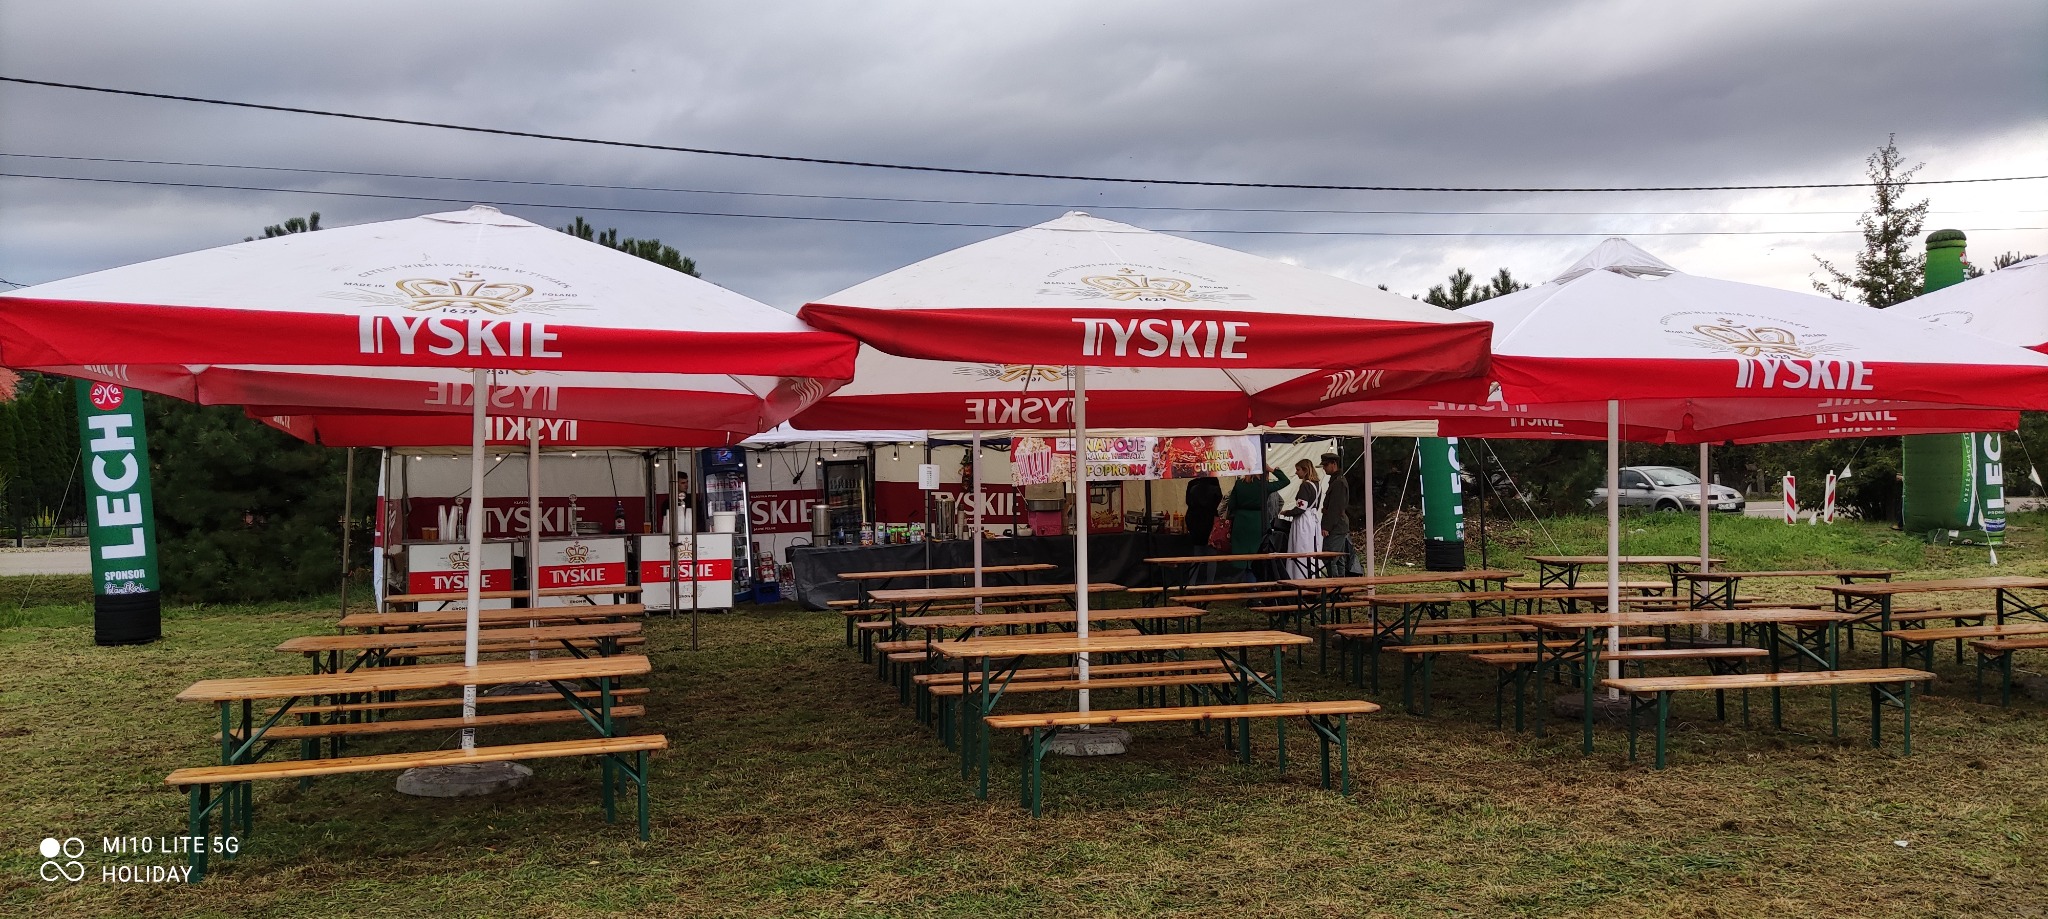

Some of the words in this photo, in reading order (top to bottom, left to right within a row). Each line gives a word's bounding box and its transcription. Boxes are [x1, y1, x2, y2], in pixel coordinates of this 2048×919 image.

[442, 307, 478, 315] 1629
[358, 316, 563, 359] TYSKIE
[1071, 317, 1250, 359] TYSKIE
[1735, 358, 1875, 391] TYSKIE
[1085, 436, 1146, 453] NAPOJE
[1205, 449, 1234, 460] WATA
[1086, 463, 1147, 477] POPKORN
[1193, 460, 1246, 472] CUKROWA
[88, 413, 147, 560] LECH
[104, 569, 146, 581] SPONSOR
[549, 567, 606, 584] TYSKIE
[659, 563, 714, 579] TSKIE
[431, 574, 491, 590] TYSE
